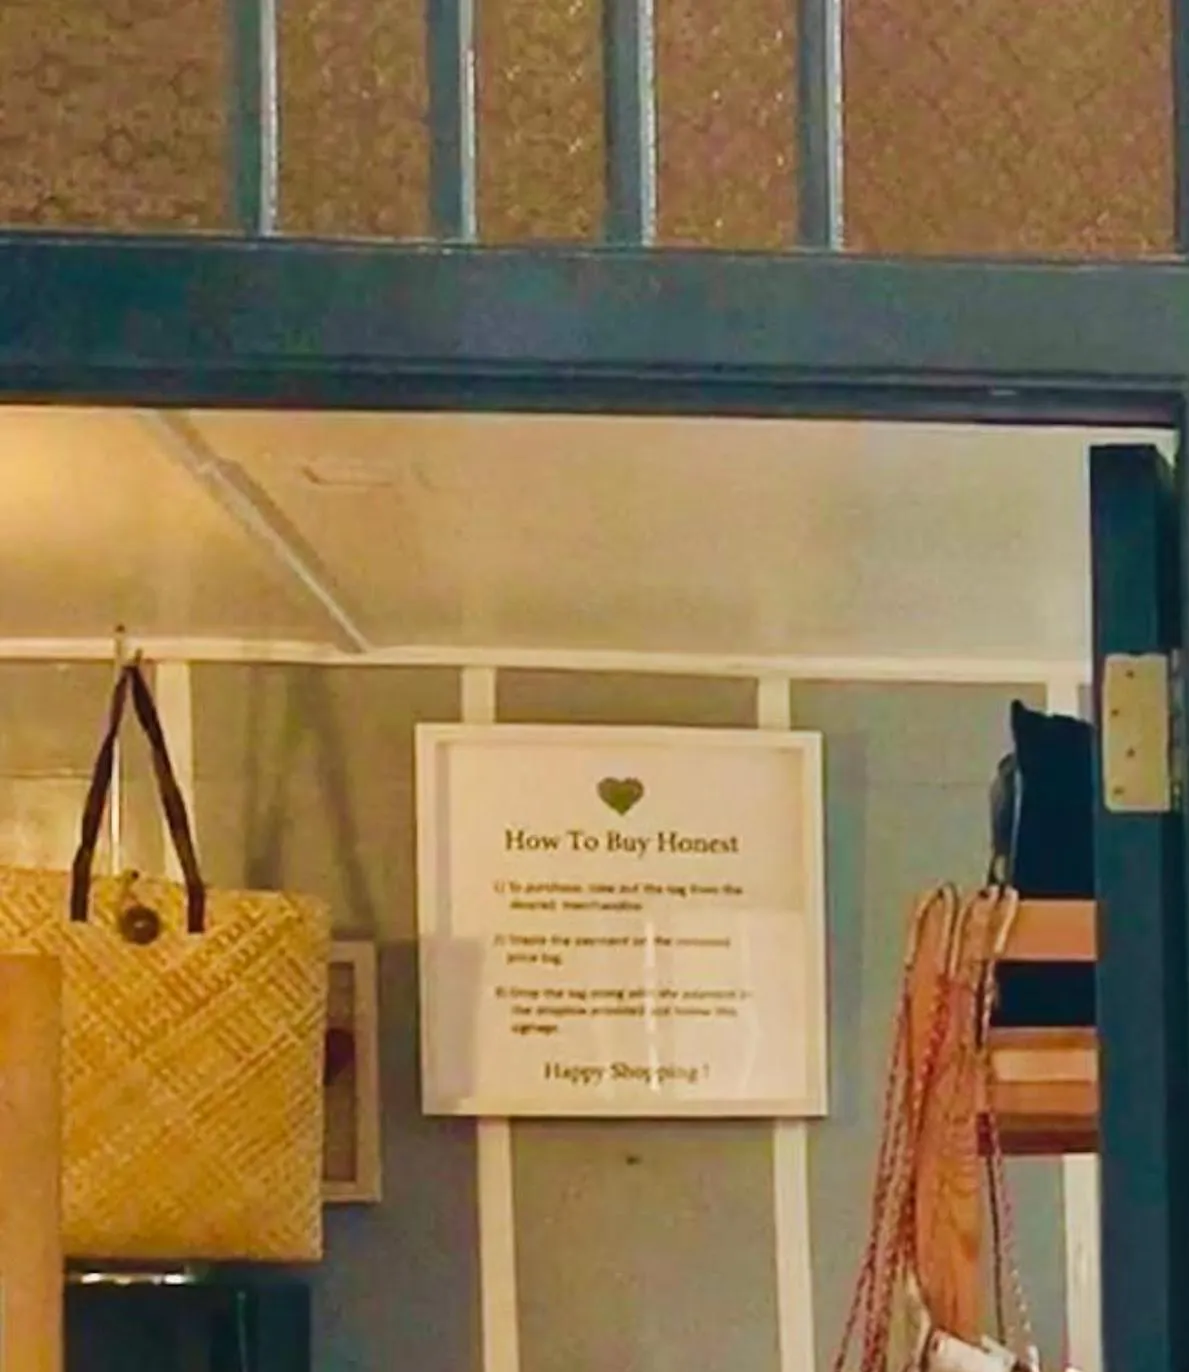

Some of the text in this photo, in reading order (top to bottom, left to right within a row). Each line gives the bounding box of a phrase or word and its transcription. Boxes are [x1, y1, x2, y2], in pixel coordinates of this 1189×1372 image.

[505, 829, 740, 858] How To Buy Honest
[544, 1062, 605, 1087] Happy
